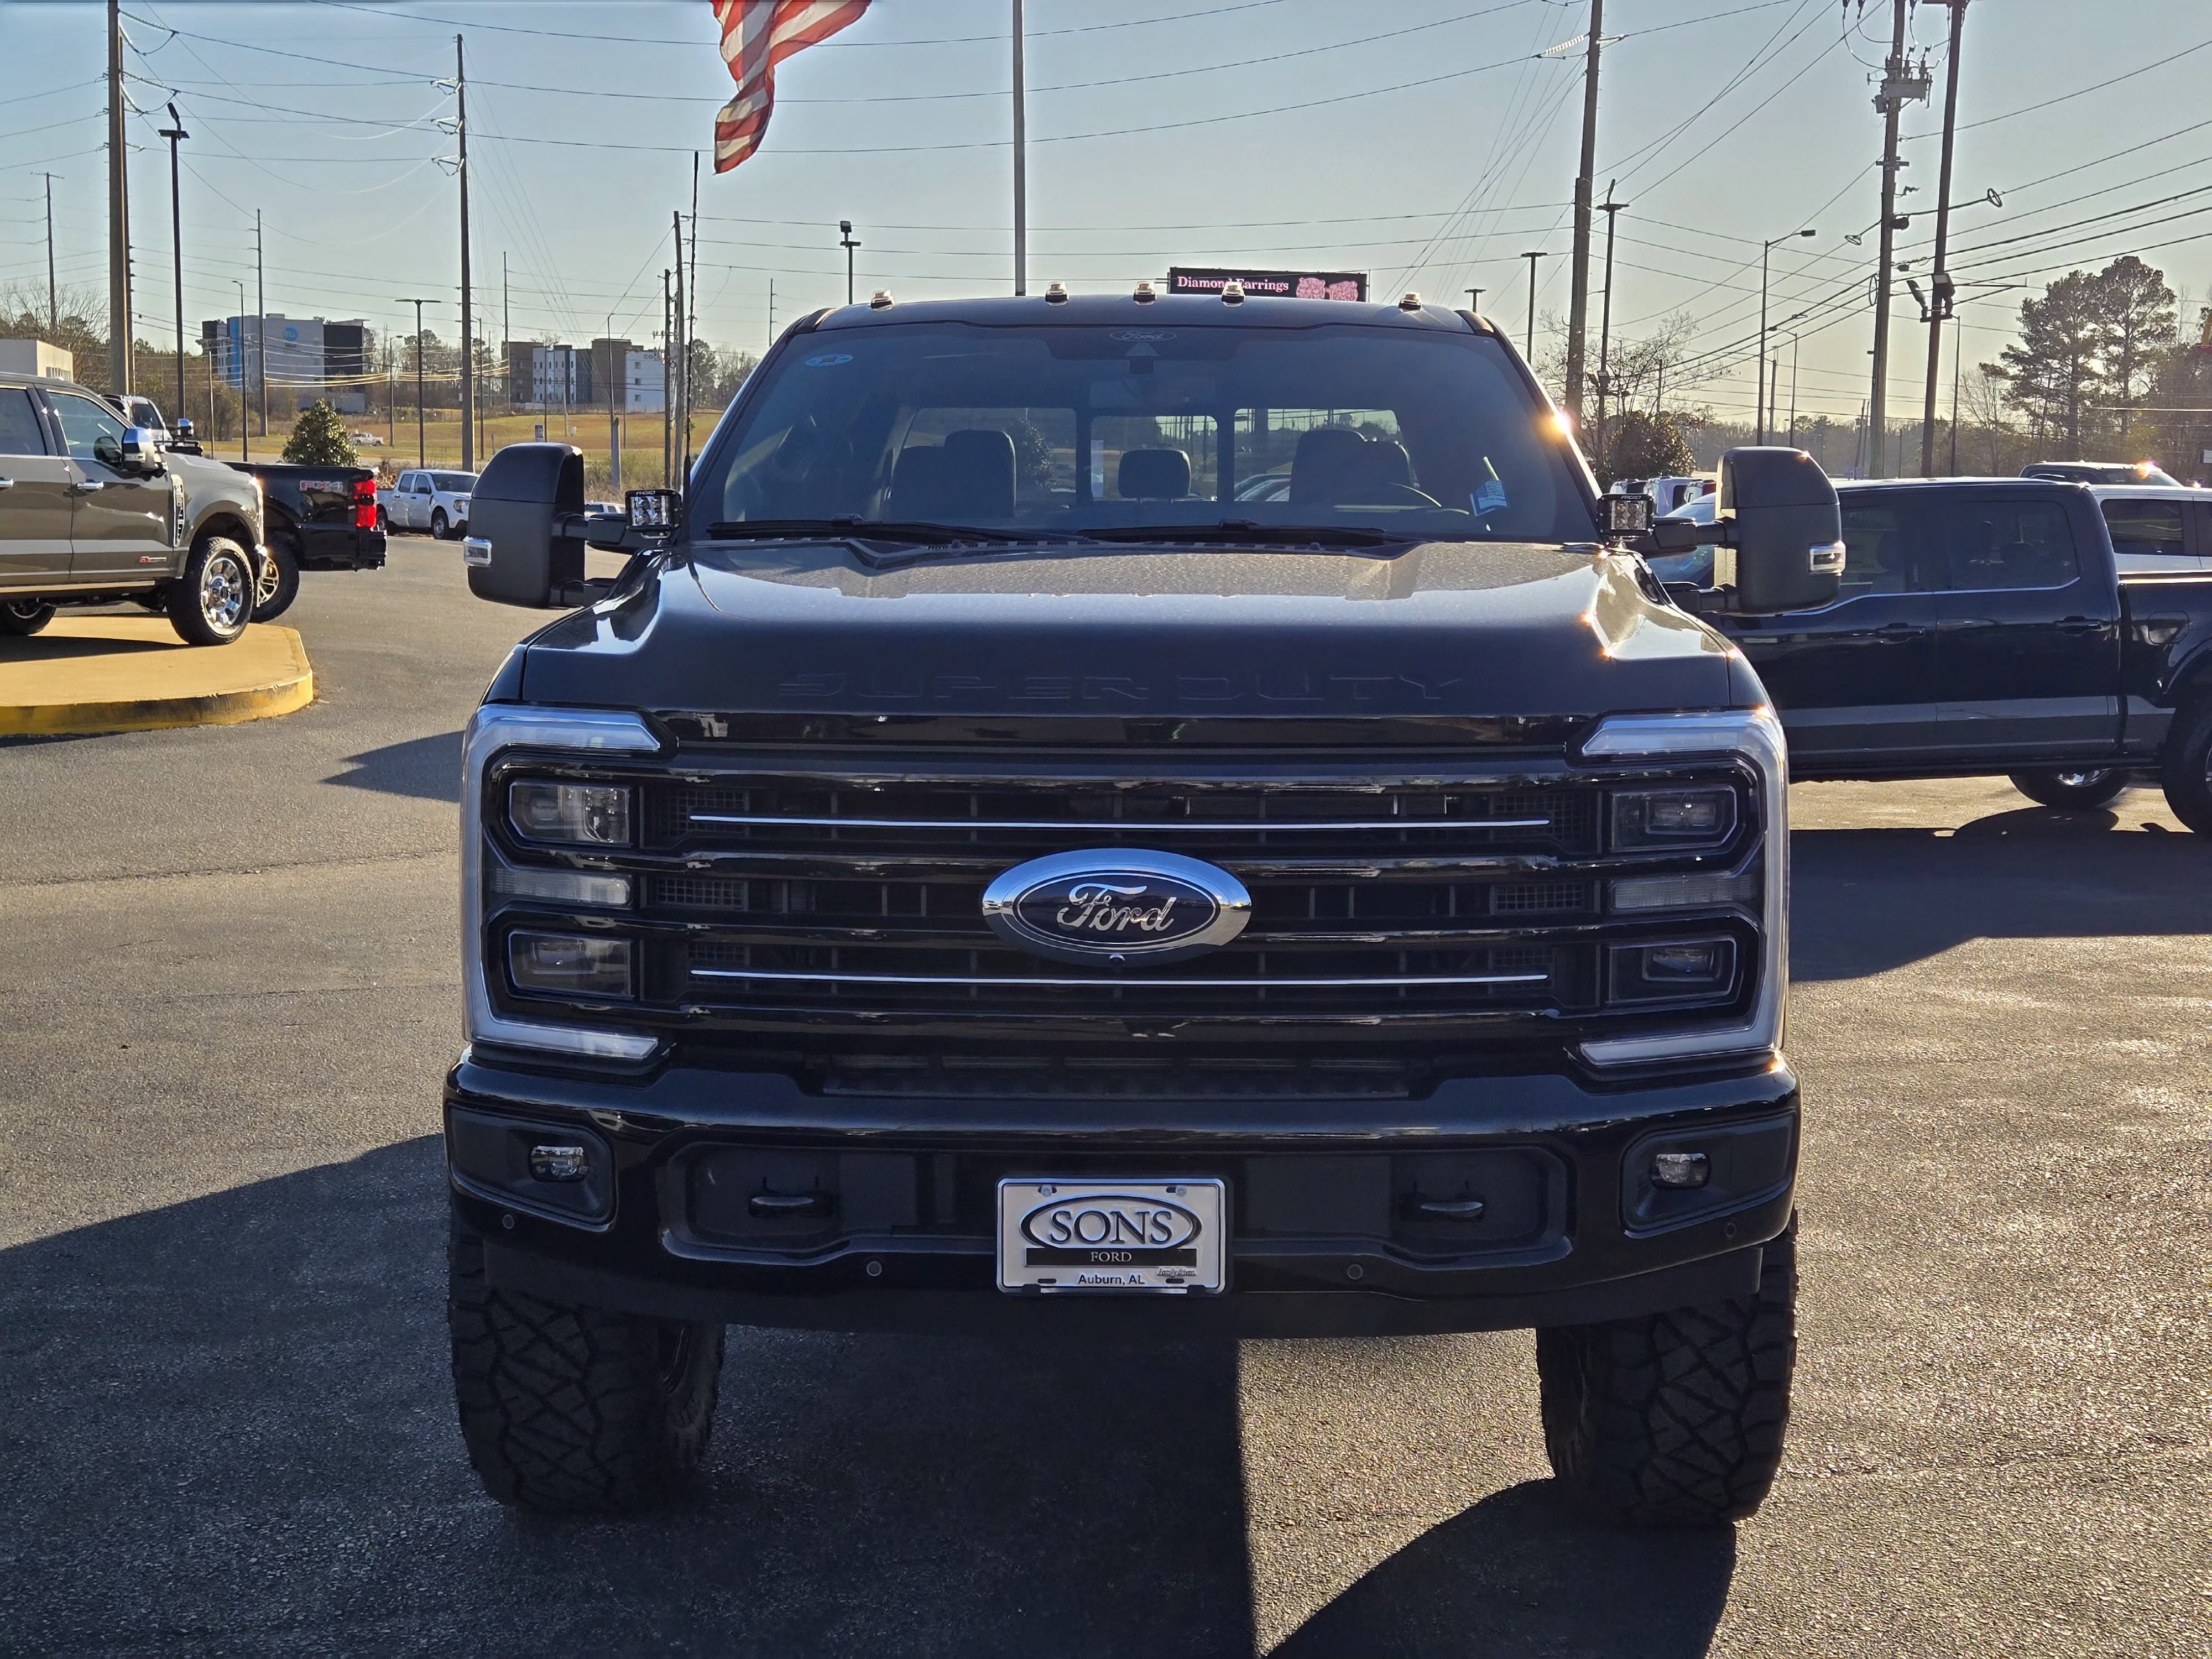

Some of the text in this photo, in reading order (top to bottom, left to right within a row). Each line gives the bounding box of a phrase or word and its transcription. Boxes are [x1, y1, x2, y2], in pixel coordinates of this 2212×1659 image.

[1177, 276, 1232, 289] Diamon
[1122, 331, 1165, 340] Ford
[300, 481, 345, 493] FX4
[1057, 883, 1177, 931] Ford
[1050, 1211, 1172, 1244] SONS
[1091, 1252, 1132, 1262] FORD
[1078, 1275, 1145, 1285] Auburn, AL
